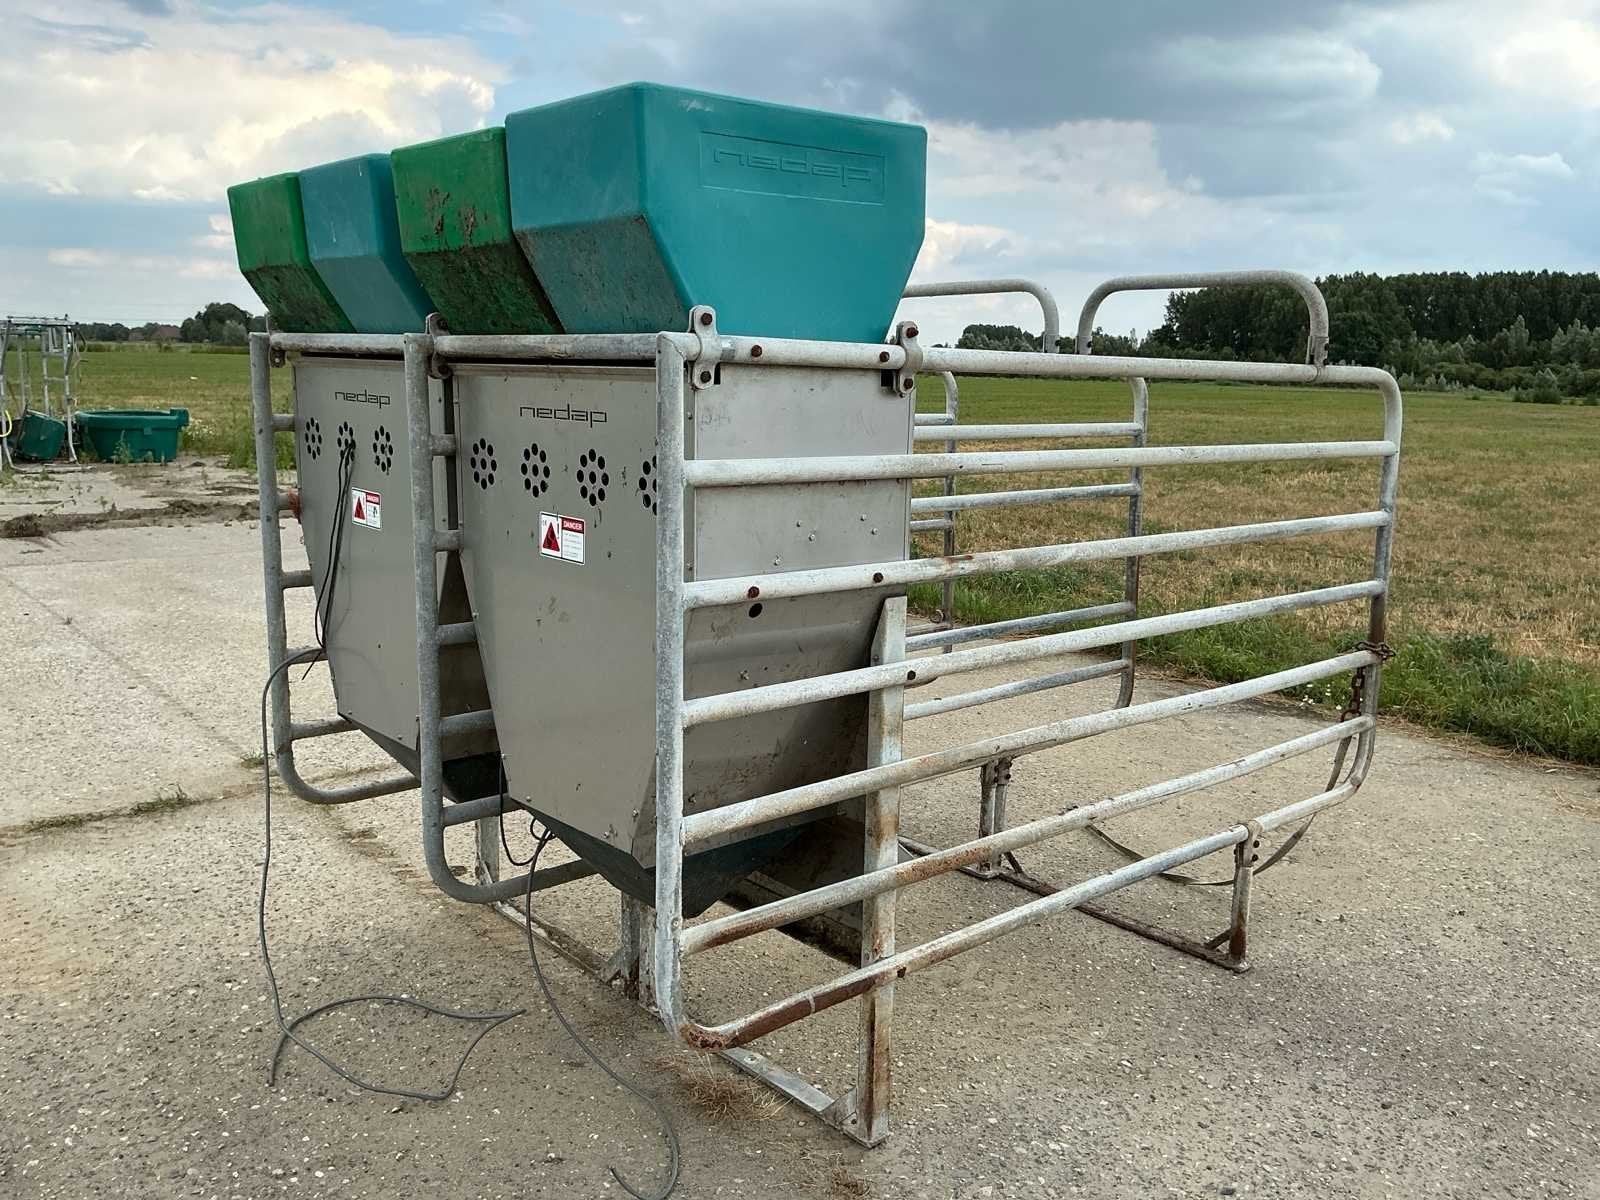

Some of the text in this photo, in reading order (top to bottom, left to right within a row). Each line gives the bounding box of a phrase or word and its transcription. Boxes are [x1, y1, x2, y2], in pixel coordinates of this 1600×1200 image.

[713, 150, 872, 188] nedap
[334, 389, 391, 409] nedap
[519, 403, 607, 428] nedap
[563, 520, 583, 531] DANGER
